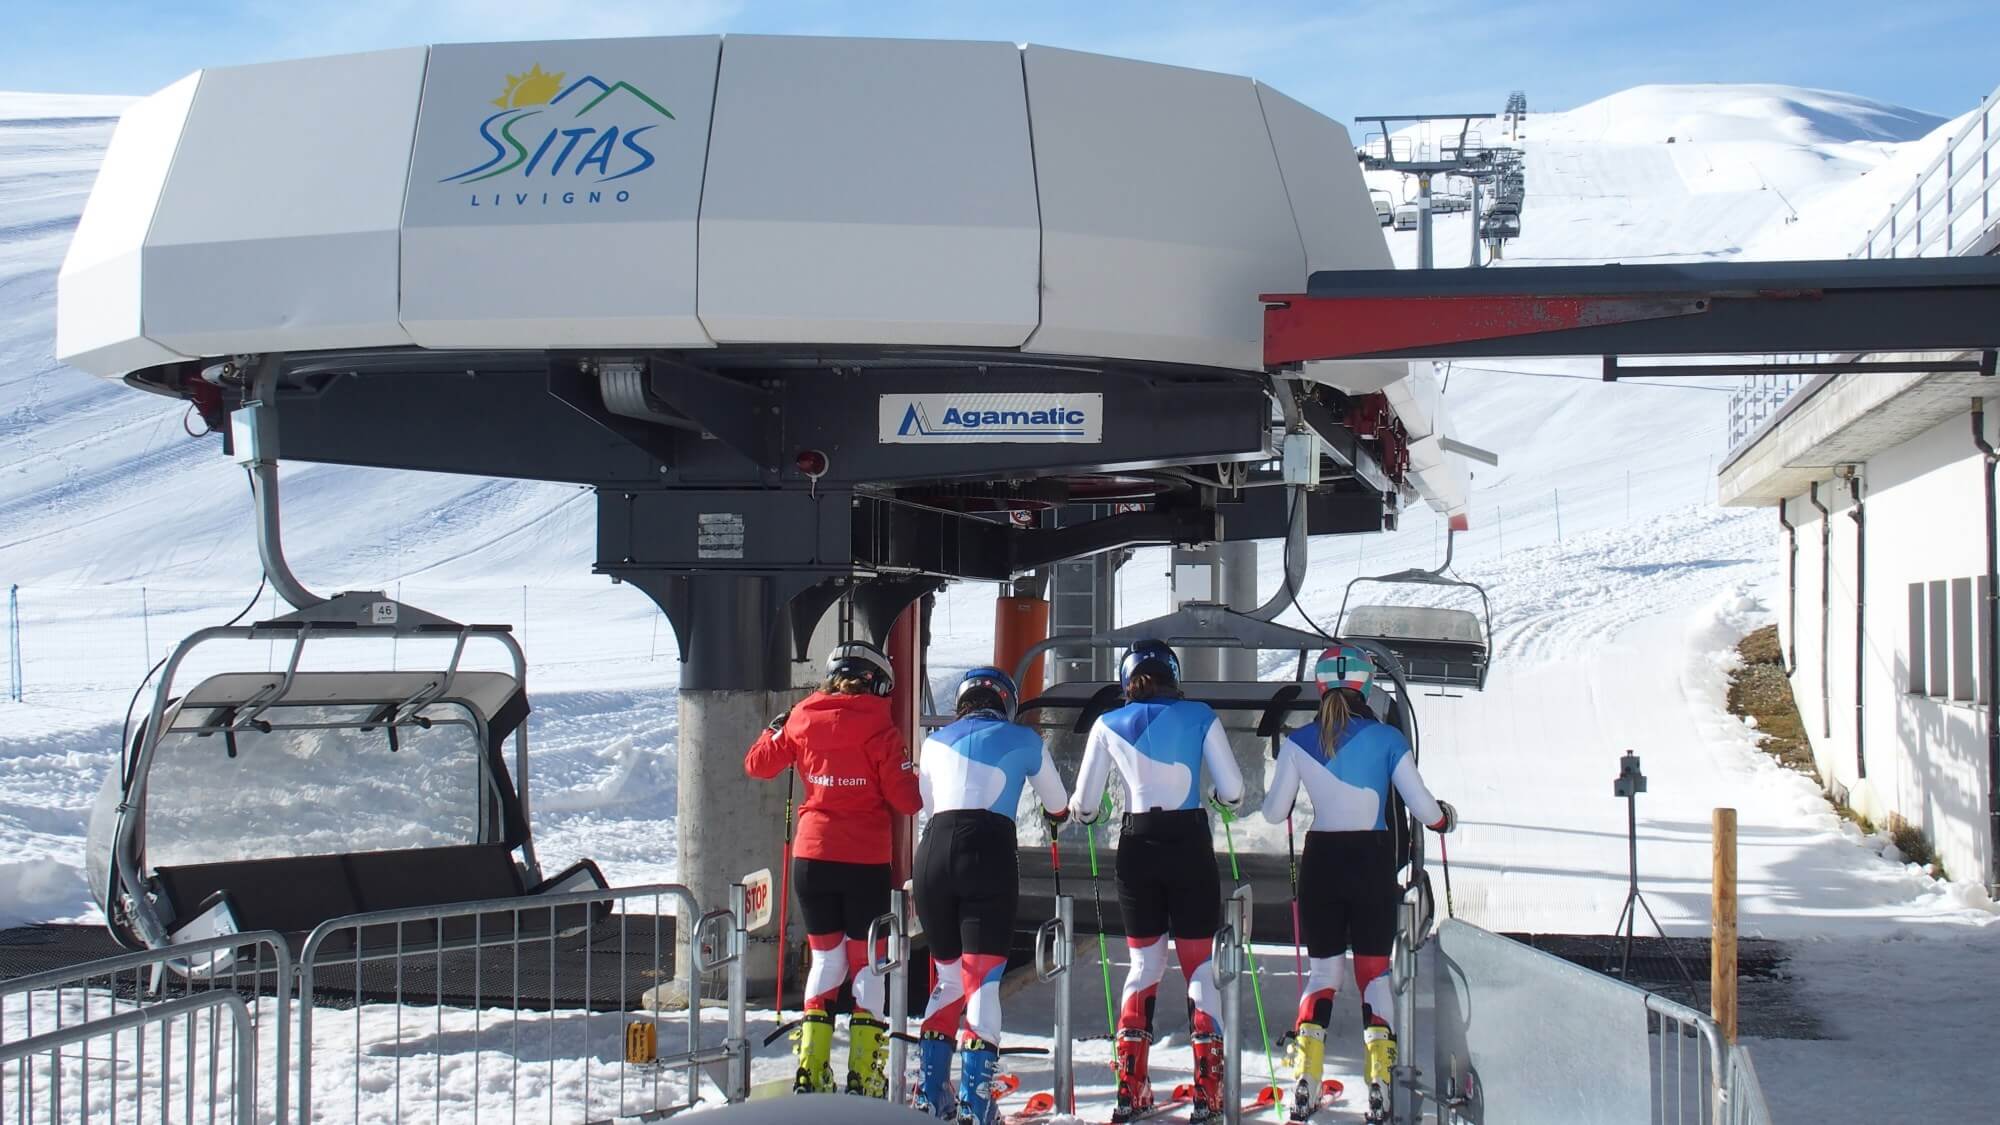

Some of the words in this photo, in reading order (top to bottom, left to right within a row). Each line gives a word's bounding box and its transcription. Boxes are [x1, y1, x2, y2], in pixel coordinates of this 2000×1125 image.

[471, 190, 630, 207] LIVIGNO
[942, 407, 1085, 428] Agamatic
[378, 605, 393, 616] 46
[838, 776, 867, 787] team
[745, 883, 768, 914] STOP
